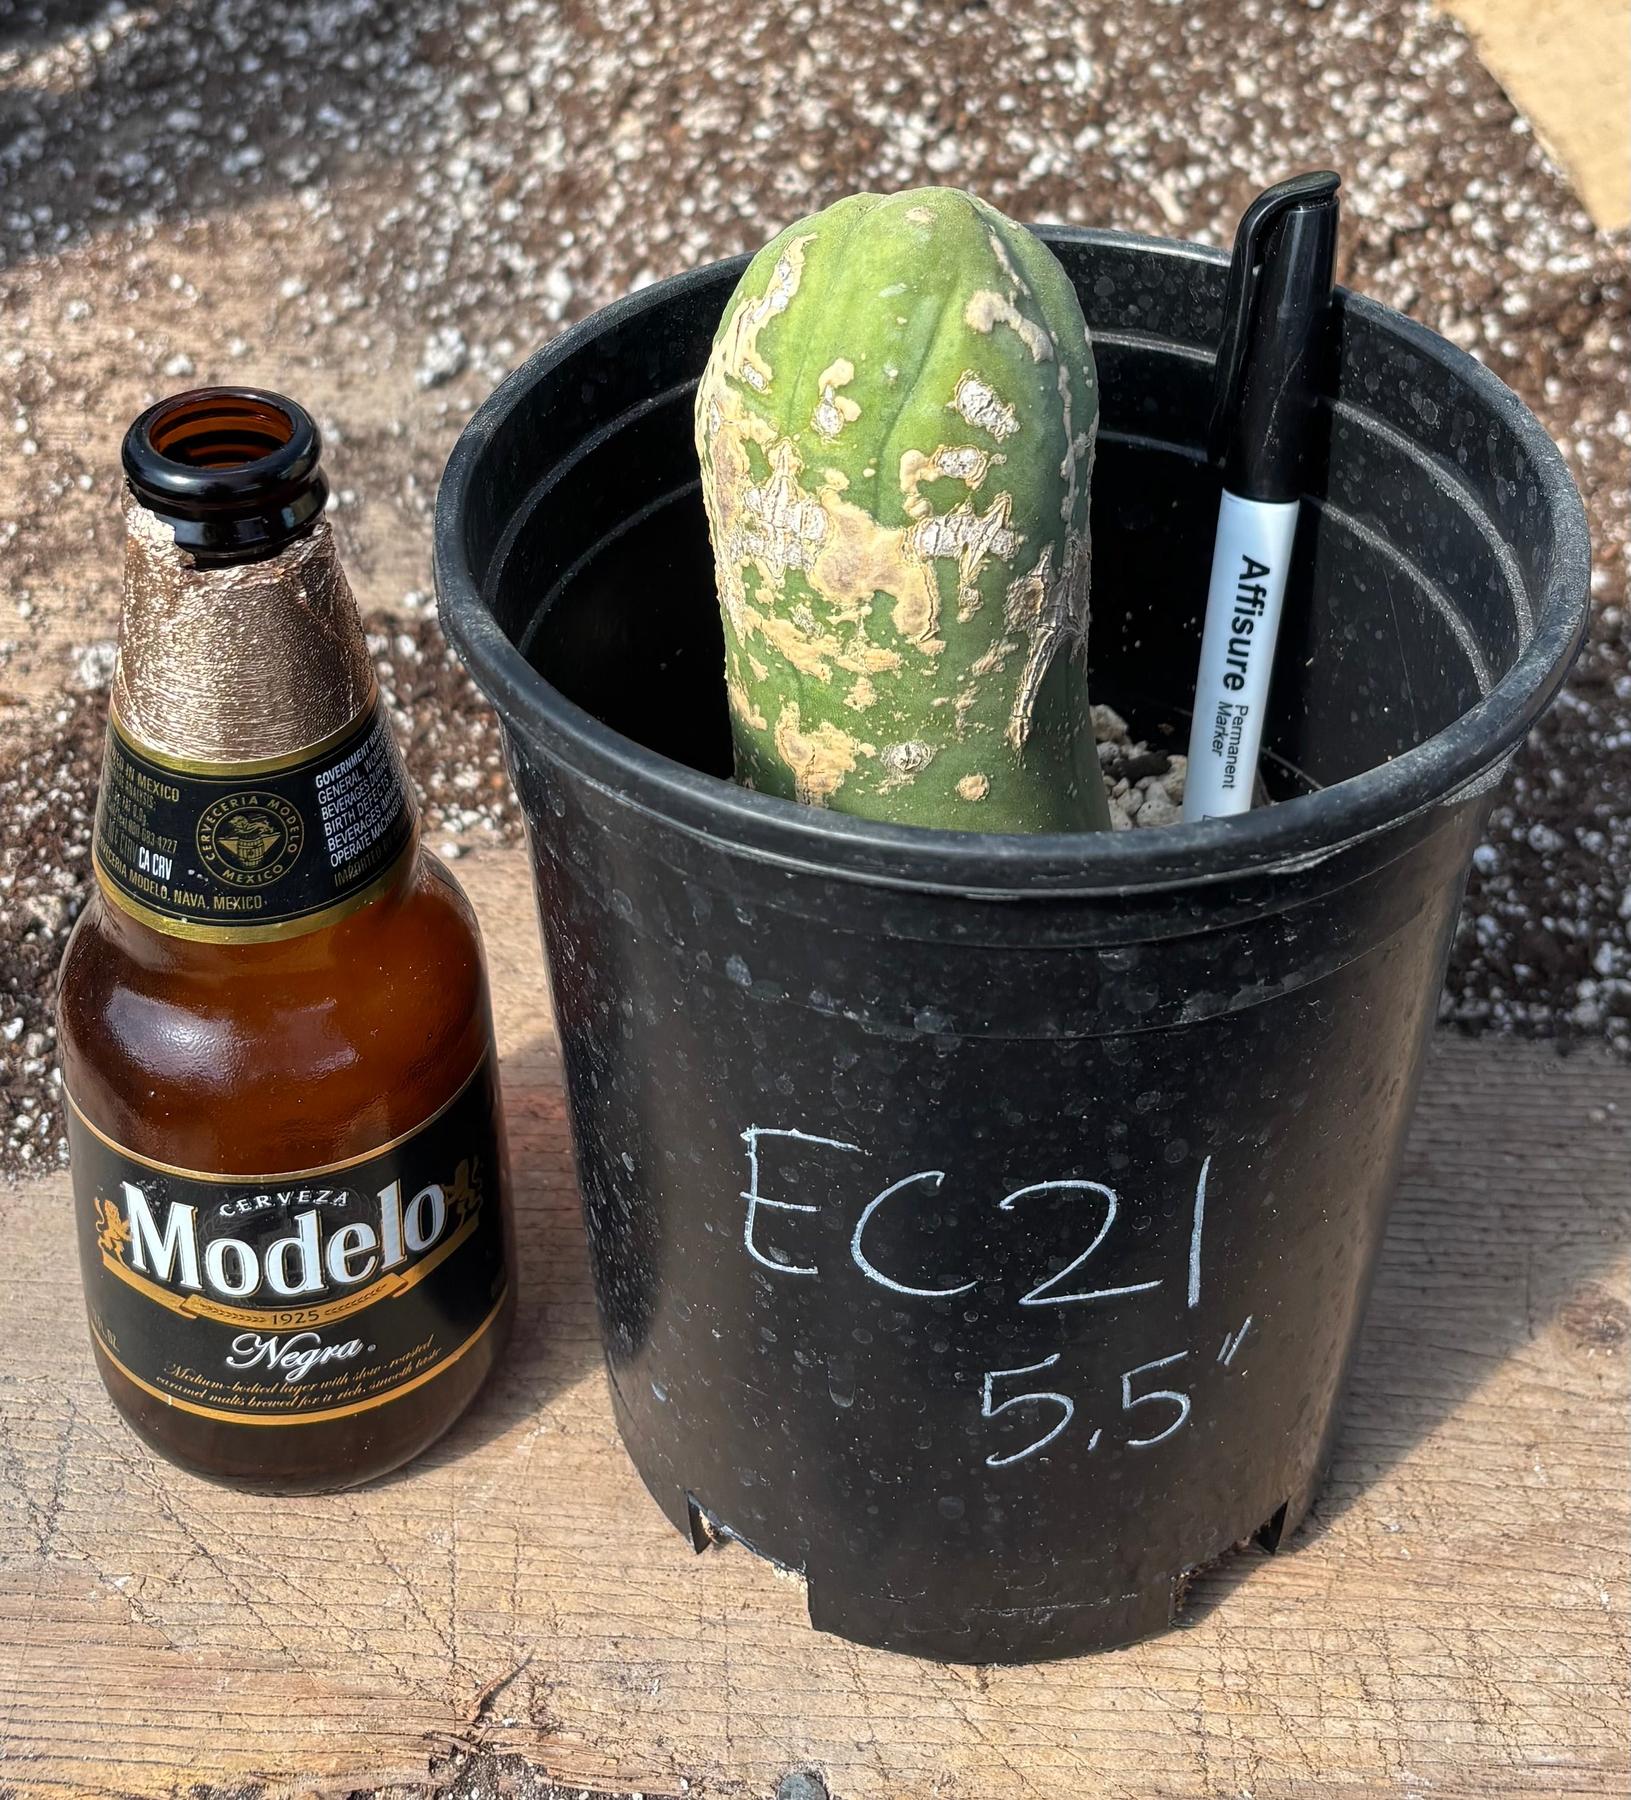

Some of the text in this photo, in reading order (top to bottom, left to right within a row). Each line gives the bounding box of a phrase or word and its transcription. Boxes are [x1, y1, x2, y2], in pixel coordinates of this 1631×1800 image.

[1222, 554, 1271, 691] Affisure
[1211, 701, 1226, 757] Marker
[1222, 704, 1249, 789] Permanent
[315, 740, 369, 788] GOVERNMENT
[137, 771, 180, 802] MEXICO
[321, 779, 370, 820] BEVERAGES
[200, 796, 258, 860] CERVECERIA
[267, 799, 300, 853] MODELO
[324, 810, 356, 836] BIRTH
[328, 804, 381, 852] BEVERAGES
[138, 846, 173, 881] CA CRV
[330, 832, 372, 867] OPERATE
[222, 864, 284, 884] MEXICO
[218, 1189, 350, 1217] CERVEZA
[120, 1179, 448, 1298] Modelo
[272, 1310, 320, 1326] 1925
[155, 1376, 207, 1400] caramel
[209, 1392, 245, 1407] malts
[248, 1393, 299, 1408] brewed
[297, 1394, 322, 1409] for
[369, 1362, 413, 1389] smooth
[415, 1347, 443, 1370] taste
[225, 1332, 364, 1383] Negra
[164, 1363, 279, 1395] Medium-bodied
[280, 1381, 318, 1398] lager
[320, 1370, 350, 1389] with
